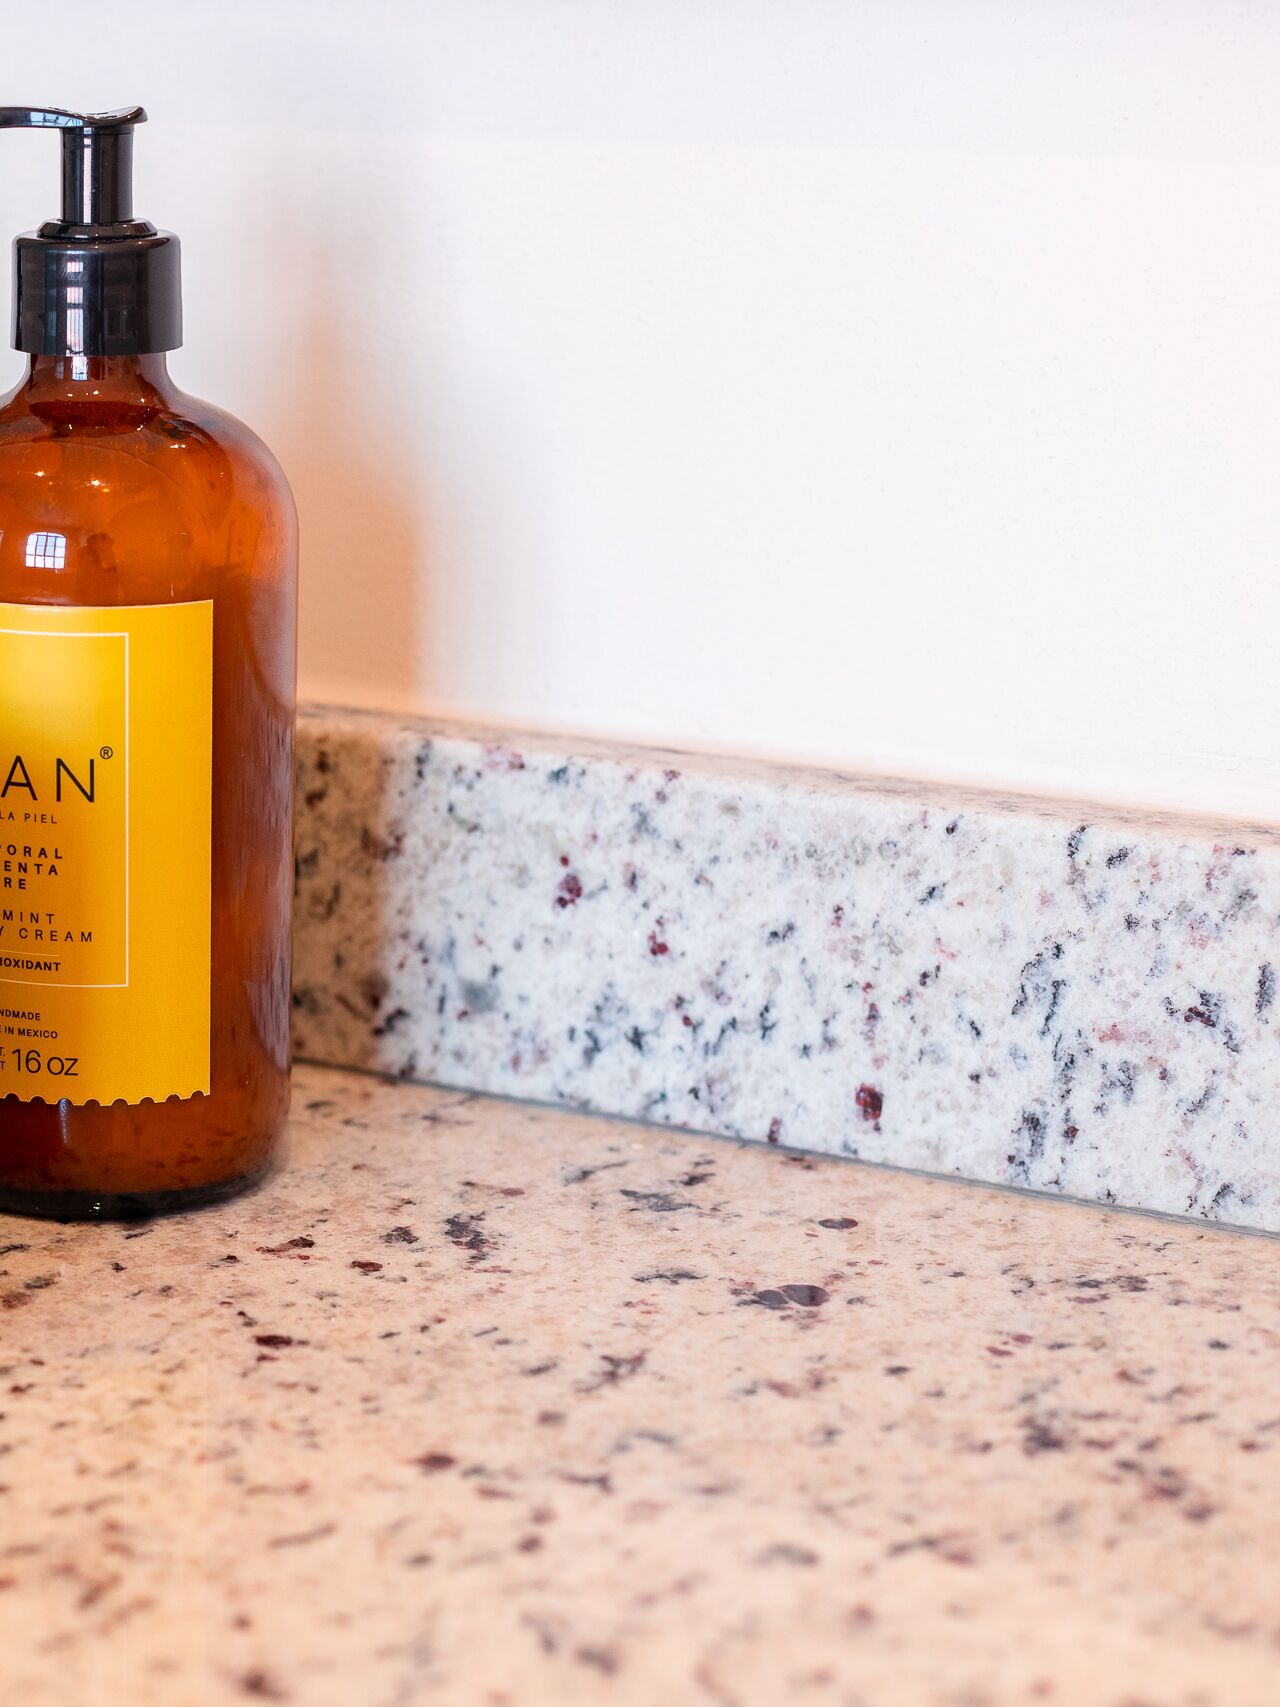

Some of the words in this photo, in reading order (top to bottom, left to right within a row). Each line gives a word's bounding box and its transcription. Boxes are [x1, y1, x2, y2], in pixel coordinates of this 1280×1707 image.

[0, 810, 15, 821] LA
[24, 813, 58, 824] PIEL
[3, 909, 55, 924] MINT
[19, 928, 93, 943] CREAM
[5, 1026, 14, 1035] IN
[18, 1028, 58, 1039] MEXICO
[12, 1048, 41, 1073] 16
